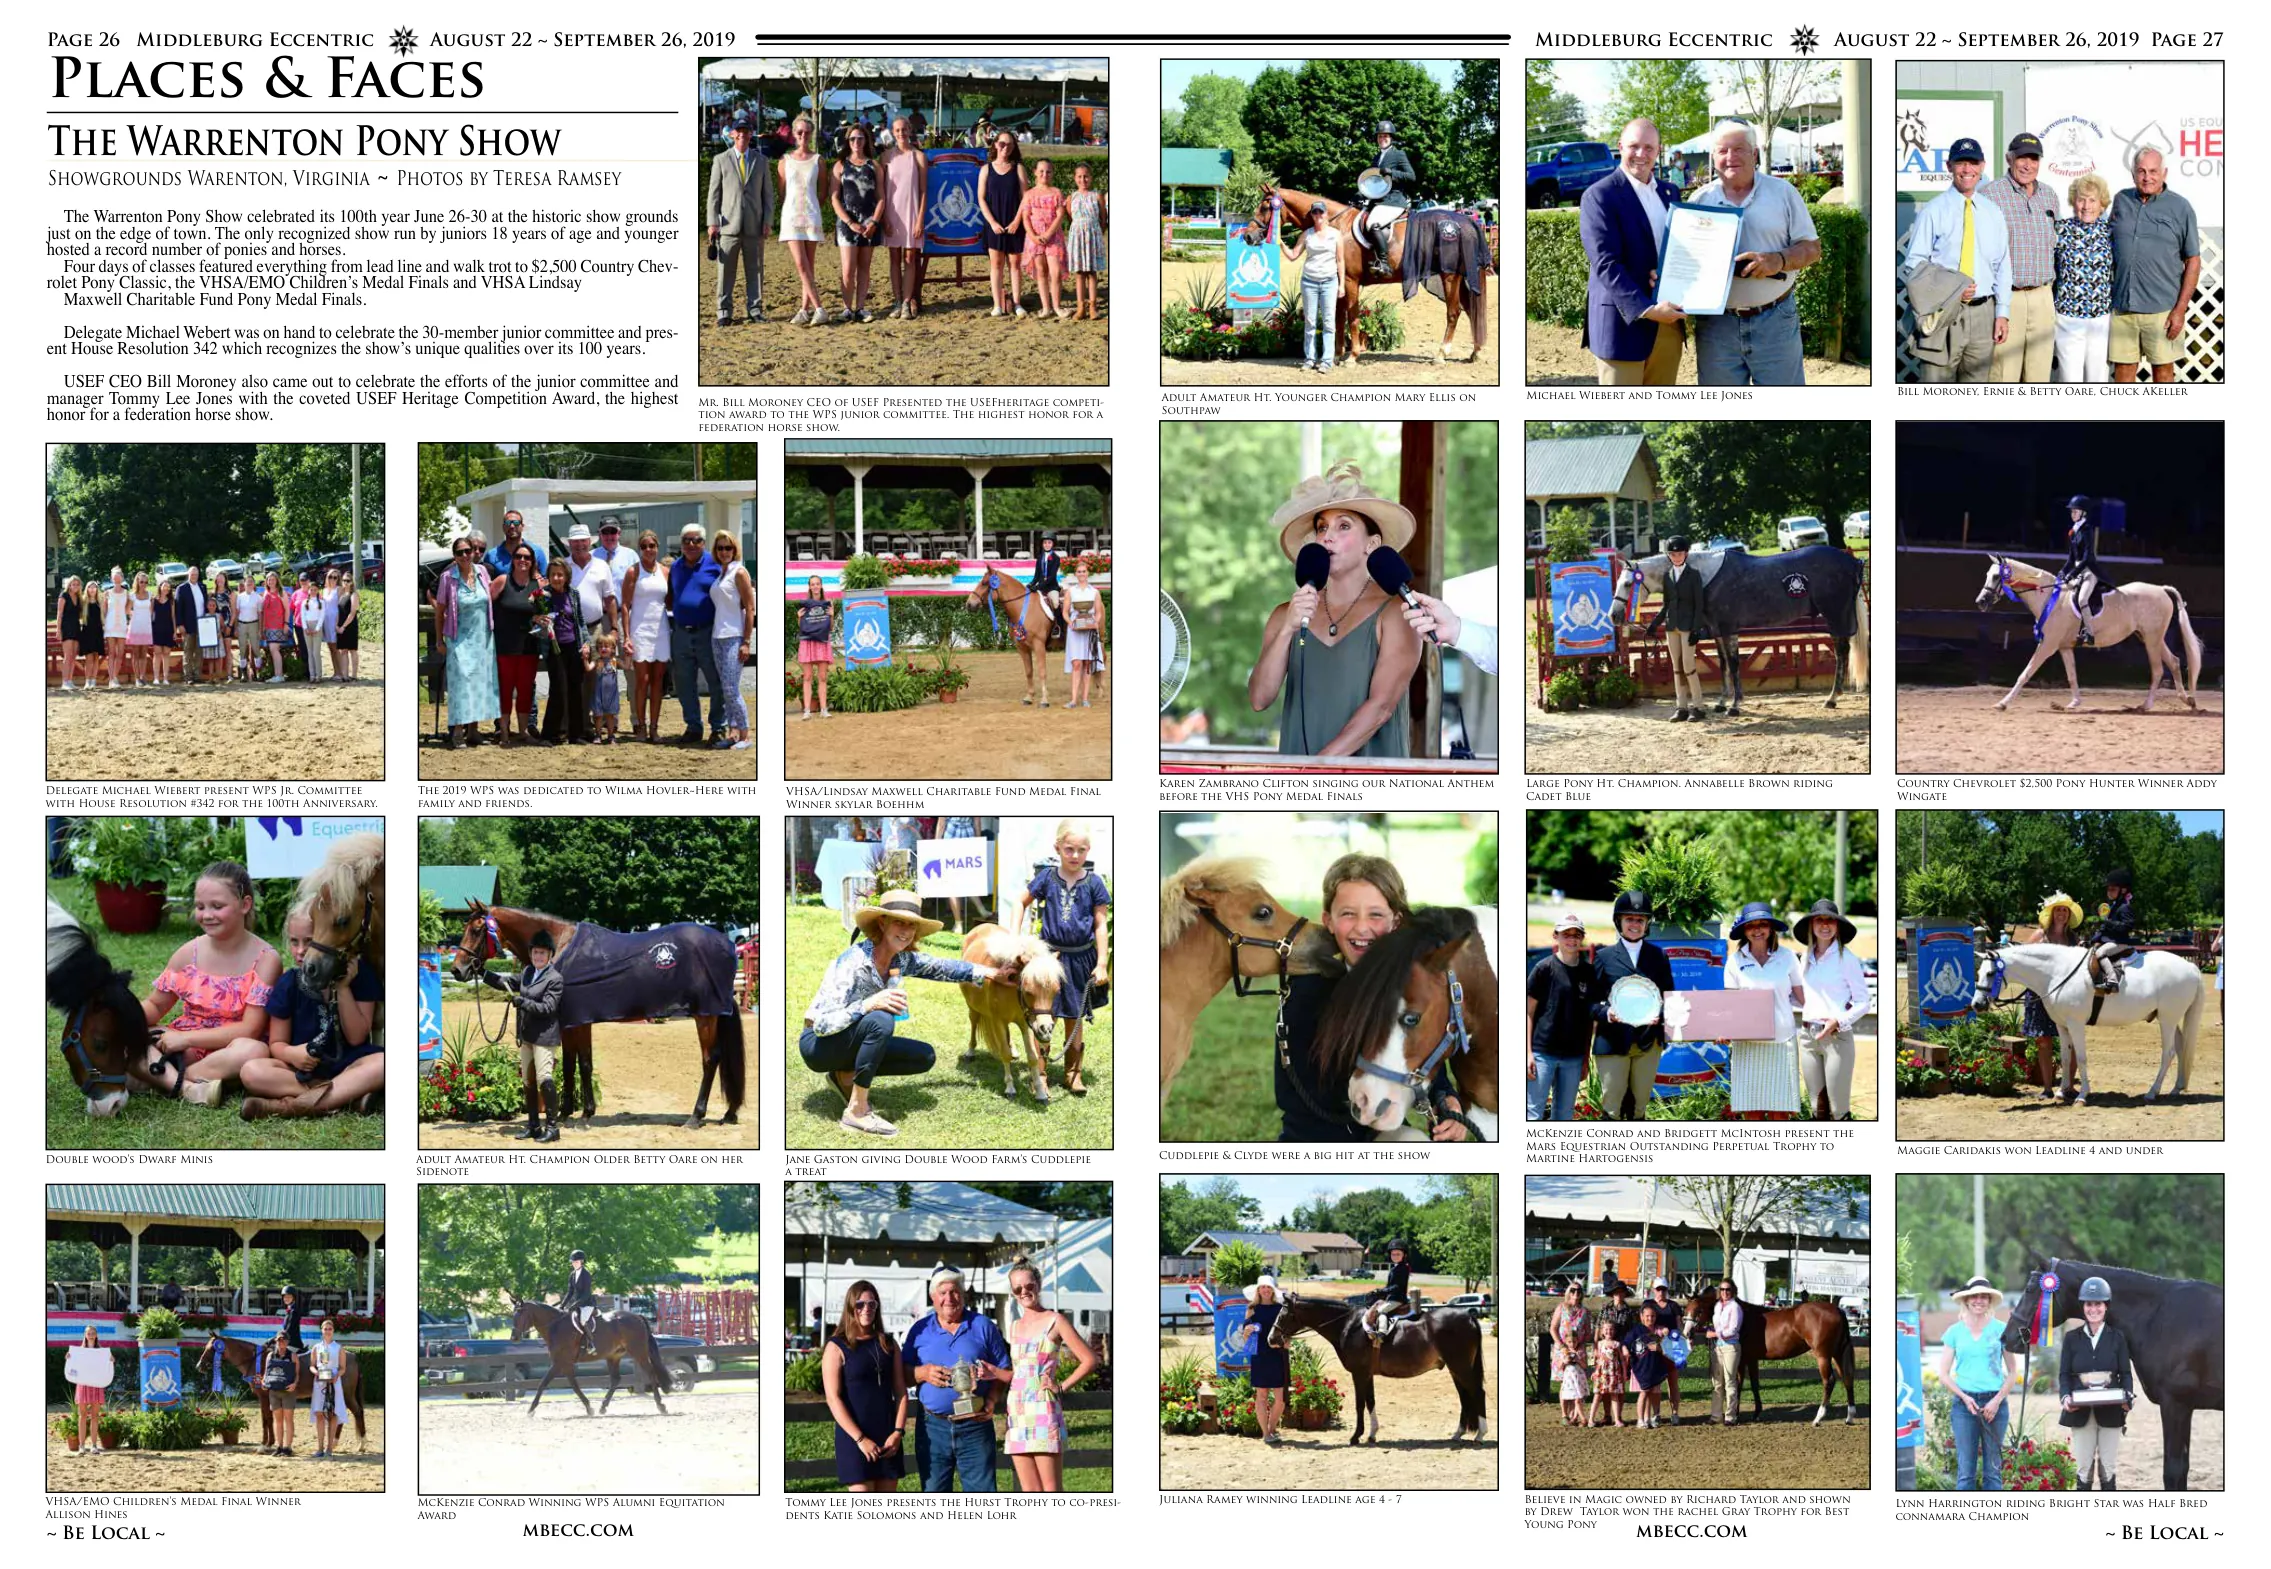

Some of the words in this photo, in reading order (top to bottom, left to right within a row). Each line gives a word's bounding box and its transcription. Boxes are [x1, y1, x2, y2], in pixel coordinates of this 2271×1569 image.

[48, 32, 92, 46] PAGE
[98, 32, 120, 47] 26
[136, 32, 262, 46] MIDDLEBURG
[269, 32, 373, 46] ECCENTRIC
[429, 32, 505, 47] AUGUST
[511, 32, 532, 46] 22
[553, 32, 656, 47] SEPTEMBER
[692, 32, 735, 46] 2019
[1535, 32, 1661, 46] MIDDLEBURG
[1668, 32, 1772, 46] ECCENTRIC
[1833, 32, 1909, 46] AUGUST
[1915, 32, 1936, 46] 22
[1958, 32, 2061, 47] SEPTEMBER
[2096, 32, 2139, 46] 2019
[2151, 32, 2196, 46] PAGE
[2202, 32, 2223, 46] 27
[51, 56, 243, 98] PLACES
[265, 55, 313, 98] &
[327, 55, 483, 98] FACES
[2038, 116, 2070, 139] Warrenton
[2072, 115, 2089, 126] Pony
[2089, 120, 2104, 139] Show
[2180, 118, 2195, 127] US
[47, 125, 116, 155] THE
[126, 125, 343, 156] WARRENTON
[356, 125, 449, 156] PONY
[459, 124, 562, 156] SHOW
[2180, 129, 2223, 157] HE
[48, 170, 181, 186] SHOWGROUNDS
[292, 170, 370, 186] VIRGINIA
[397, 170, 462, 186] PHOTOS
[470, 172, 488, 185] BY
[492, 170, 552, 185] TERESA
[558, 170, 621, 185] RAMSEY
[63, 210, 89, 222] The
[93, 210, 162, 222] Warrenton
[167, 210, 200, 228] Pony
[205, 210, 242, 222] Show
[247, 209, 315, 222] celebrated
[319, 209, 334, 222] its
[341, 210, 377, 222] 100th
[381, 213, 410, 226] year
[413, 210, 444, 222] June
[448, 209, 487, 222] 26-30
[491, 212, 503, 222] at
[507, 210, 527, 222] the
[532, 209, 581, 222] historic
[586, 210, 620, 222] show
[625, 210, 678, 226] grounds
[63, 292, 122, 305] Maxwell
[126, 293, 195, 305] Charitable
[199, 293, 233, 305] Fund
[237, 293, 271, 309] Pony
[275, 292, 317, 305] Medal
[321, 293, 366, 305] Finals.
[1526, 390, 1576, 400] MICHAEL
[1578, 390, 1625, 400] WIEBERT
[1628, 391, 1652, 400] AND
[1655, 390, 1696, 400] TOMMY
[1700, 390, 1717, 400] LEE
[1721, 390, 1752, 402] JONES
[1897, 386, 1919, 396] BILL
[1983, 386, 2014, 396] ERNIE
[2017, 386, 2026, 396] &
[2030, 386, 2061, 396] BETTY
[2099, 386, 2139, 396] CHUCK
[46, 395, 104, 410] manager
[108, 392, 159, 410] Tommy
[165, 392, 190, 404] Lee
[195, 392, 232, 404] Jones
[238, 392, 267, 404] with
[273, 392, 293, 404] the
[299, 392, 350, 404] coveted
[356, 392, 397, 404] USEF
[402, 392, 459, 408] Heritage
[464, 392, 547, 408] Competition
[604, 392, 625, 404] the
[630, 392, 678, 408] highest
[1161, 405, 1220, 415] SOUTHPAW
[1526, 778, 1559, 788] LARGE
[1564, 778, 1593, 788] PONY
[1684, 778, 1744, 788] ANNABELLE
[1748, 778, 1789, 788] BROWN
[1793, 779, 1832, 788] RIDING
[785, 786, 868, 796] VHSA/LINDSAY
[871, 786, 923, 796] MAXWELL
[926, 786, 991, 796] CHARITABLE
[995, 786, 1025, 796] FUND
[1029, 786, 1066, 796] MEDAL
[1070, 786, 1101, 796] FINAL
[1526, 791, 1562, 801] CADET
[1565, 791, 1591, 801] BLUE
[786, 799, 832, 809] WINNER
[834, 800, 873, 809] SKYLAR
[876, 799, 924, 809] BOEHHM
[945, 855, 983, 870] MARS
[46, 1154, 88, 1164] DOUBLE
[139, 1154, 176, 1164] DWARF
[180, 1154, 212, 1164] MINIS
[1159, 1150, 1219, 1160] CUDDLEPIE
[1222, 1150, 1231, 1160] &
[1234, 1150, 1268, 1160] CLYDE
[1271, 1151, 1300, 1160] WERE
[1303, 1152, 1310, 1160] A
[1314, 1151, 1331, 1160] BIG
[1335, 1151, 1354, 1160] HIT
[1357, 1151, 1370, 1160] AT
[1373, 1151, 1394, 1160] THE
[1397, 1151, 1430, 1160] SHOW
[45, 1496, 109, 1506] VHSA/EMO
[180, 1496, 217, 1506] MEDAL
[221, 1496, 252, 1506] FINAL
[255, 1496, 301, 1506] WINNER
[417, 1497, 474, 1507] MCKENZIE
[478, 1497, 525, 1507] CONRAD
[528, 1497, 581, 1507] WINNING
[585, 1497, 609, 1507] WPS
[612, 1497, 654, 1507] ALUMNI
[659, 1497, 724, 1509] EQUITATION
[1896, 1498, 1924, 1508] LYNN
[1928, 1498, 2001, 1508] HARRINGTON
[2006, 1499, 2045, 1508] RIDING
[2049, 1498, 2090, 1508] BRIGHT
[2093, 1498, 2119, 1508] STAR
[2122, 1499, 2143, 1508] WAS
[2148, 1498, 2175, 1508] HALF
[2179, 1498, 2207, 1508] BRED
[45, 1509, 90, 1519] ALLISON
[94, 1509, 127, 1519] HINES
[417, 1510, 456, 1520] AWARD
[1895, 1512, 1965, 1521] CONNAMARA
[1968, 1511, 2028, 1521] CHAMPION
[63, 1525, 84, 1539] BE
[91, 1525, 150, 1539] LOCAL
[522, 1524, 634, 1536] MBECC.COM
[1636, 1525, 1747, 1537] MBECC.COM
[2122, 1525, 2143, 1539] BE
[2150, 1525, 2208, 1539] LOCAL
